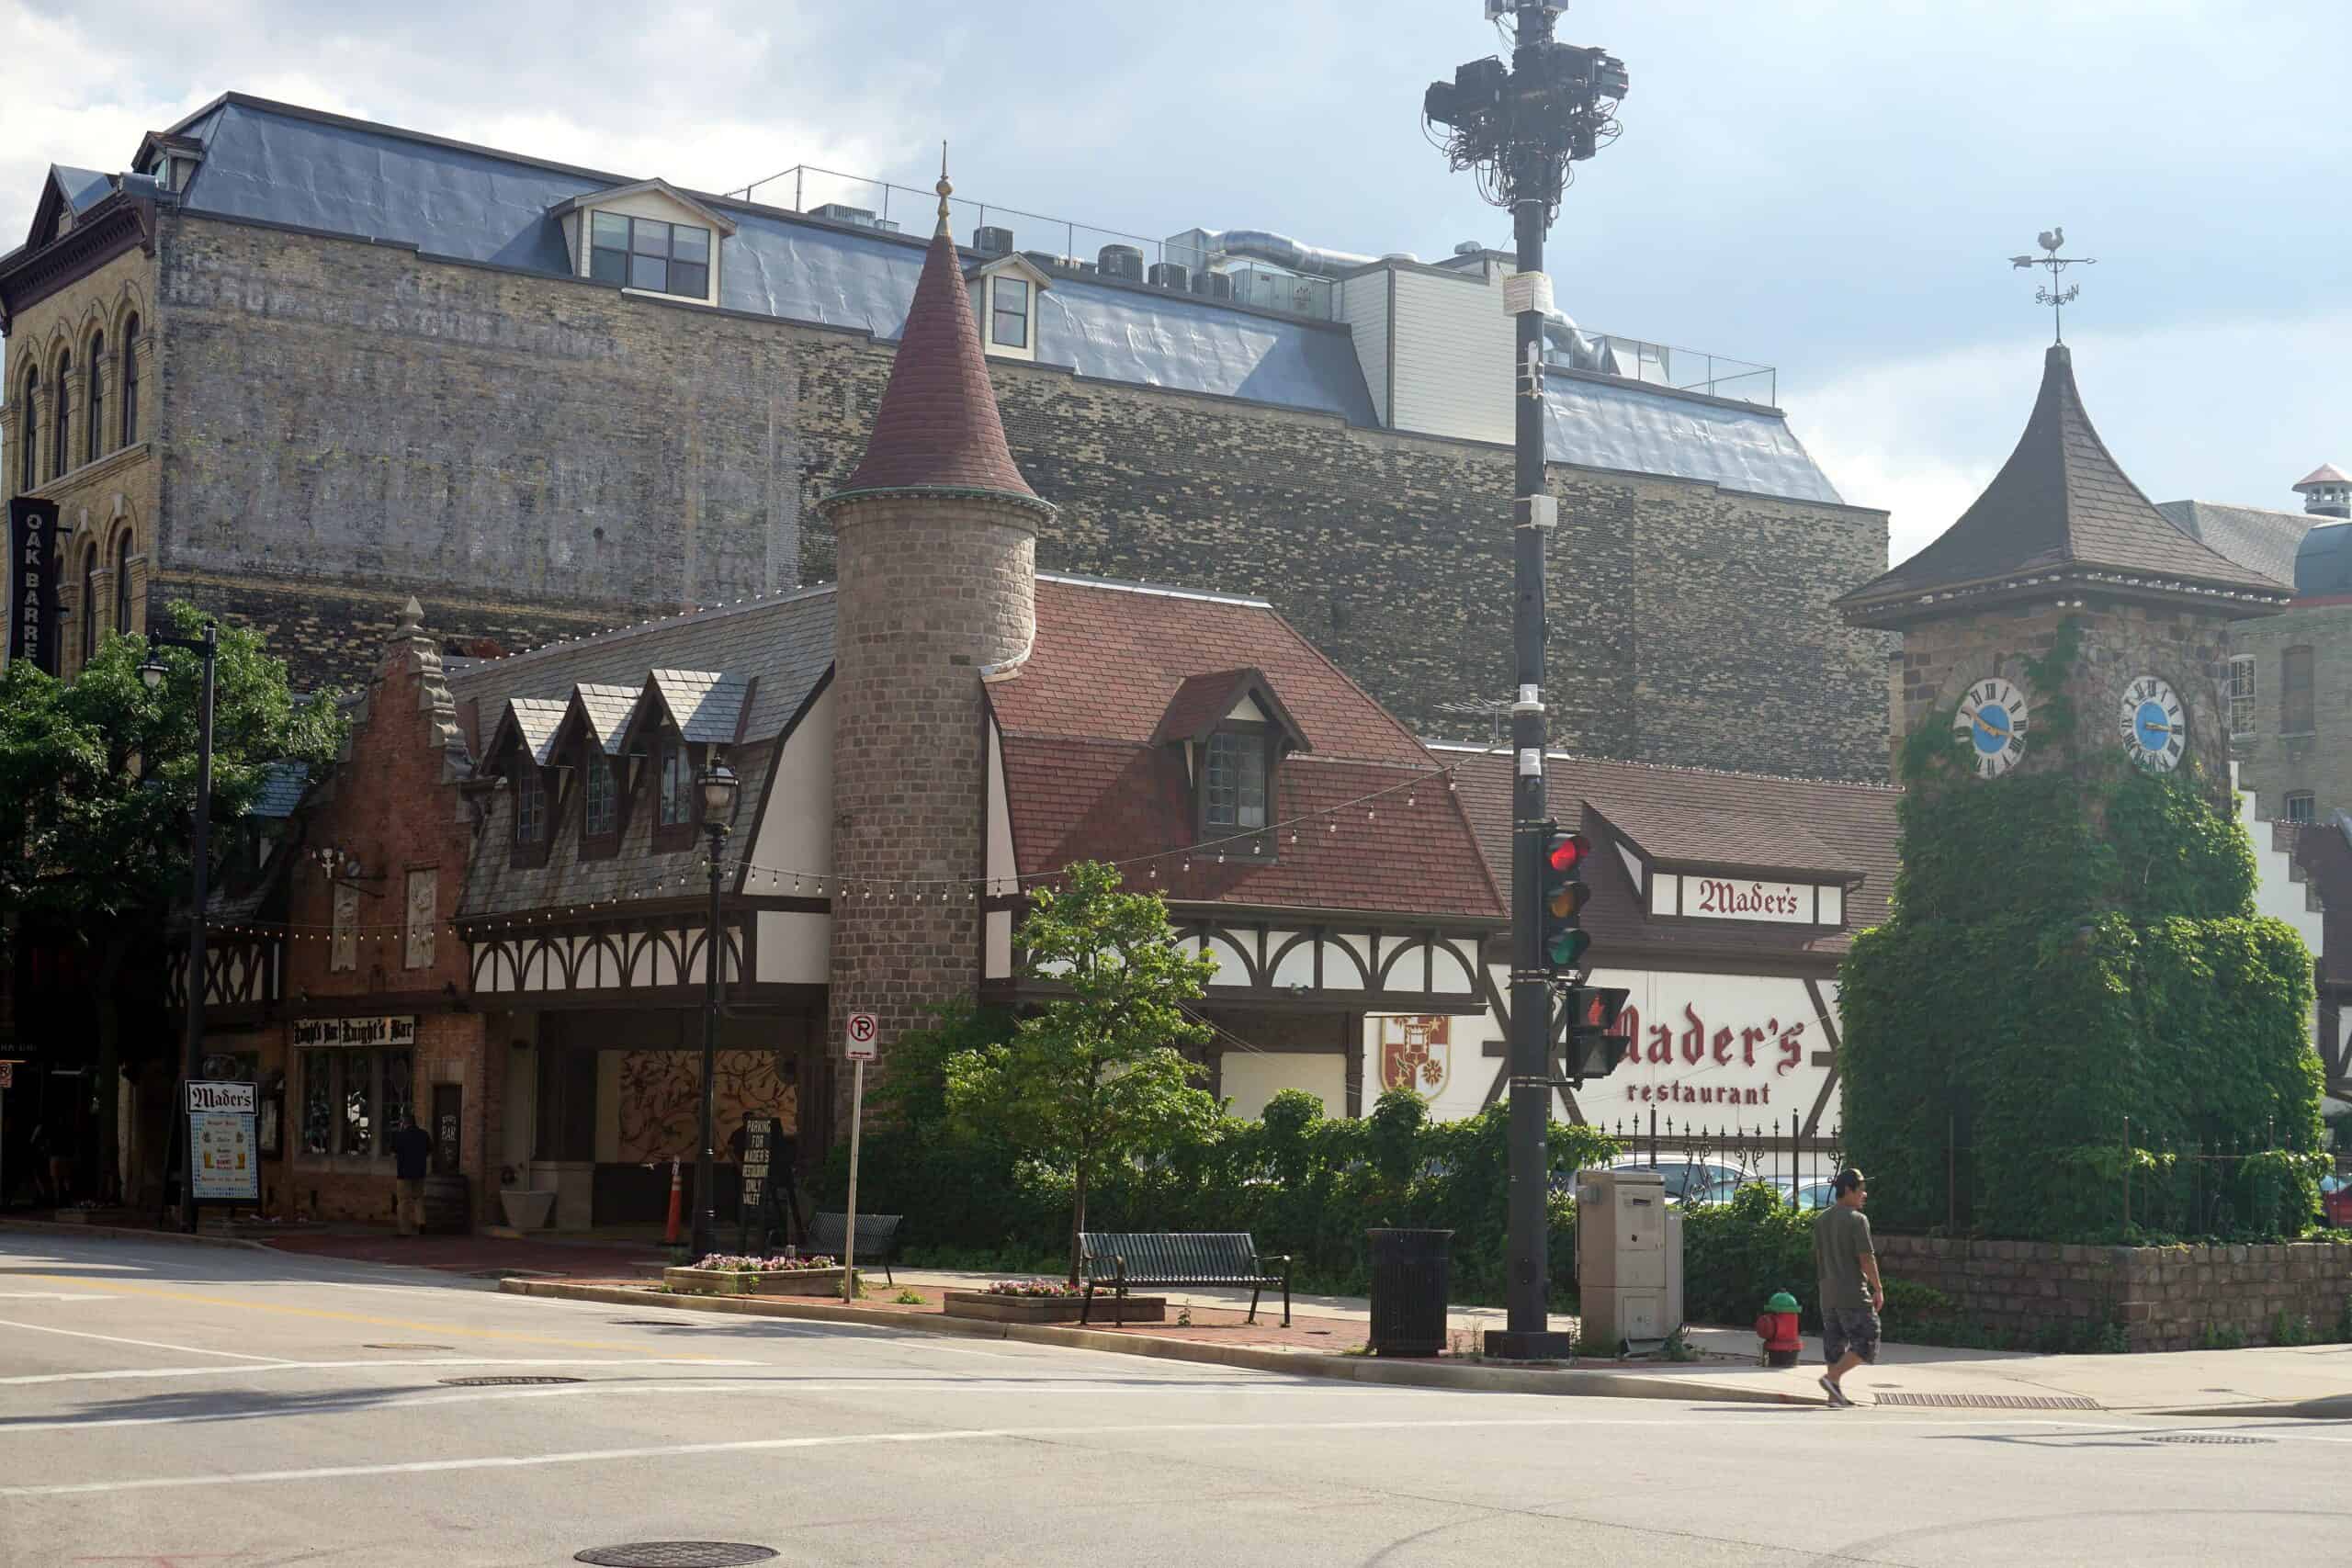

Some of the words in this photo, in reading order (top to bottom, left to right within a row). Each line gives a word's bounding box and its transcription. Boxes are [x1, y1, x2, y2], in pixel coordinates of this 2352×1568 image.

[25, 513, 42, 565] OAK
[1698, 879, 1799, 914] Mader's
[343, 1019, 384, 1044] Knight's
[192, 1088, 252, 1108] Mader's
[1627, 1080, 1771, 1104] restaurant
[746, 1120, 771, 1132] PARKING
[752, 1134, 764, 1147] FOR
[745, 1179, 763, 1192] ONLY
